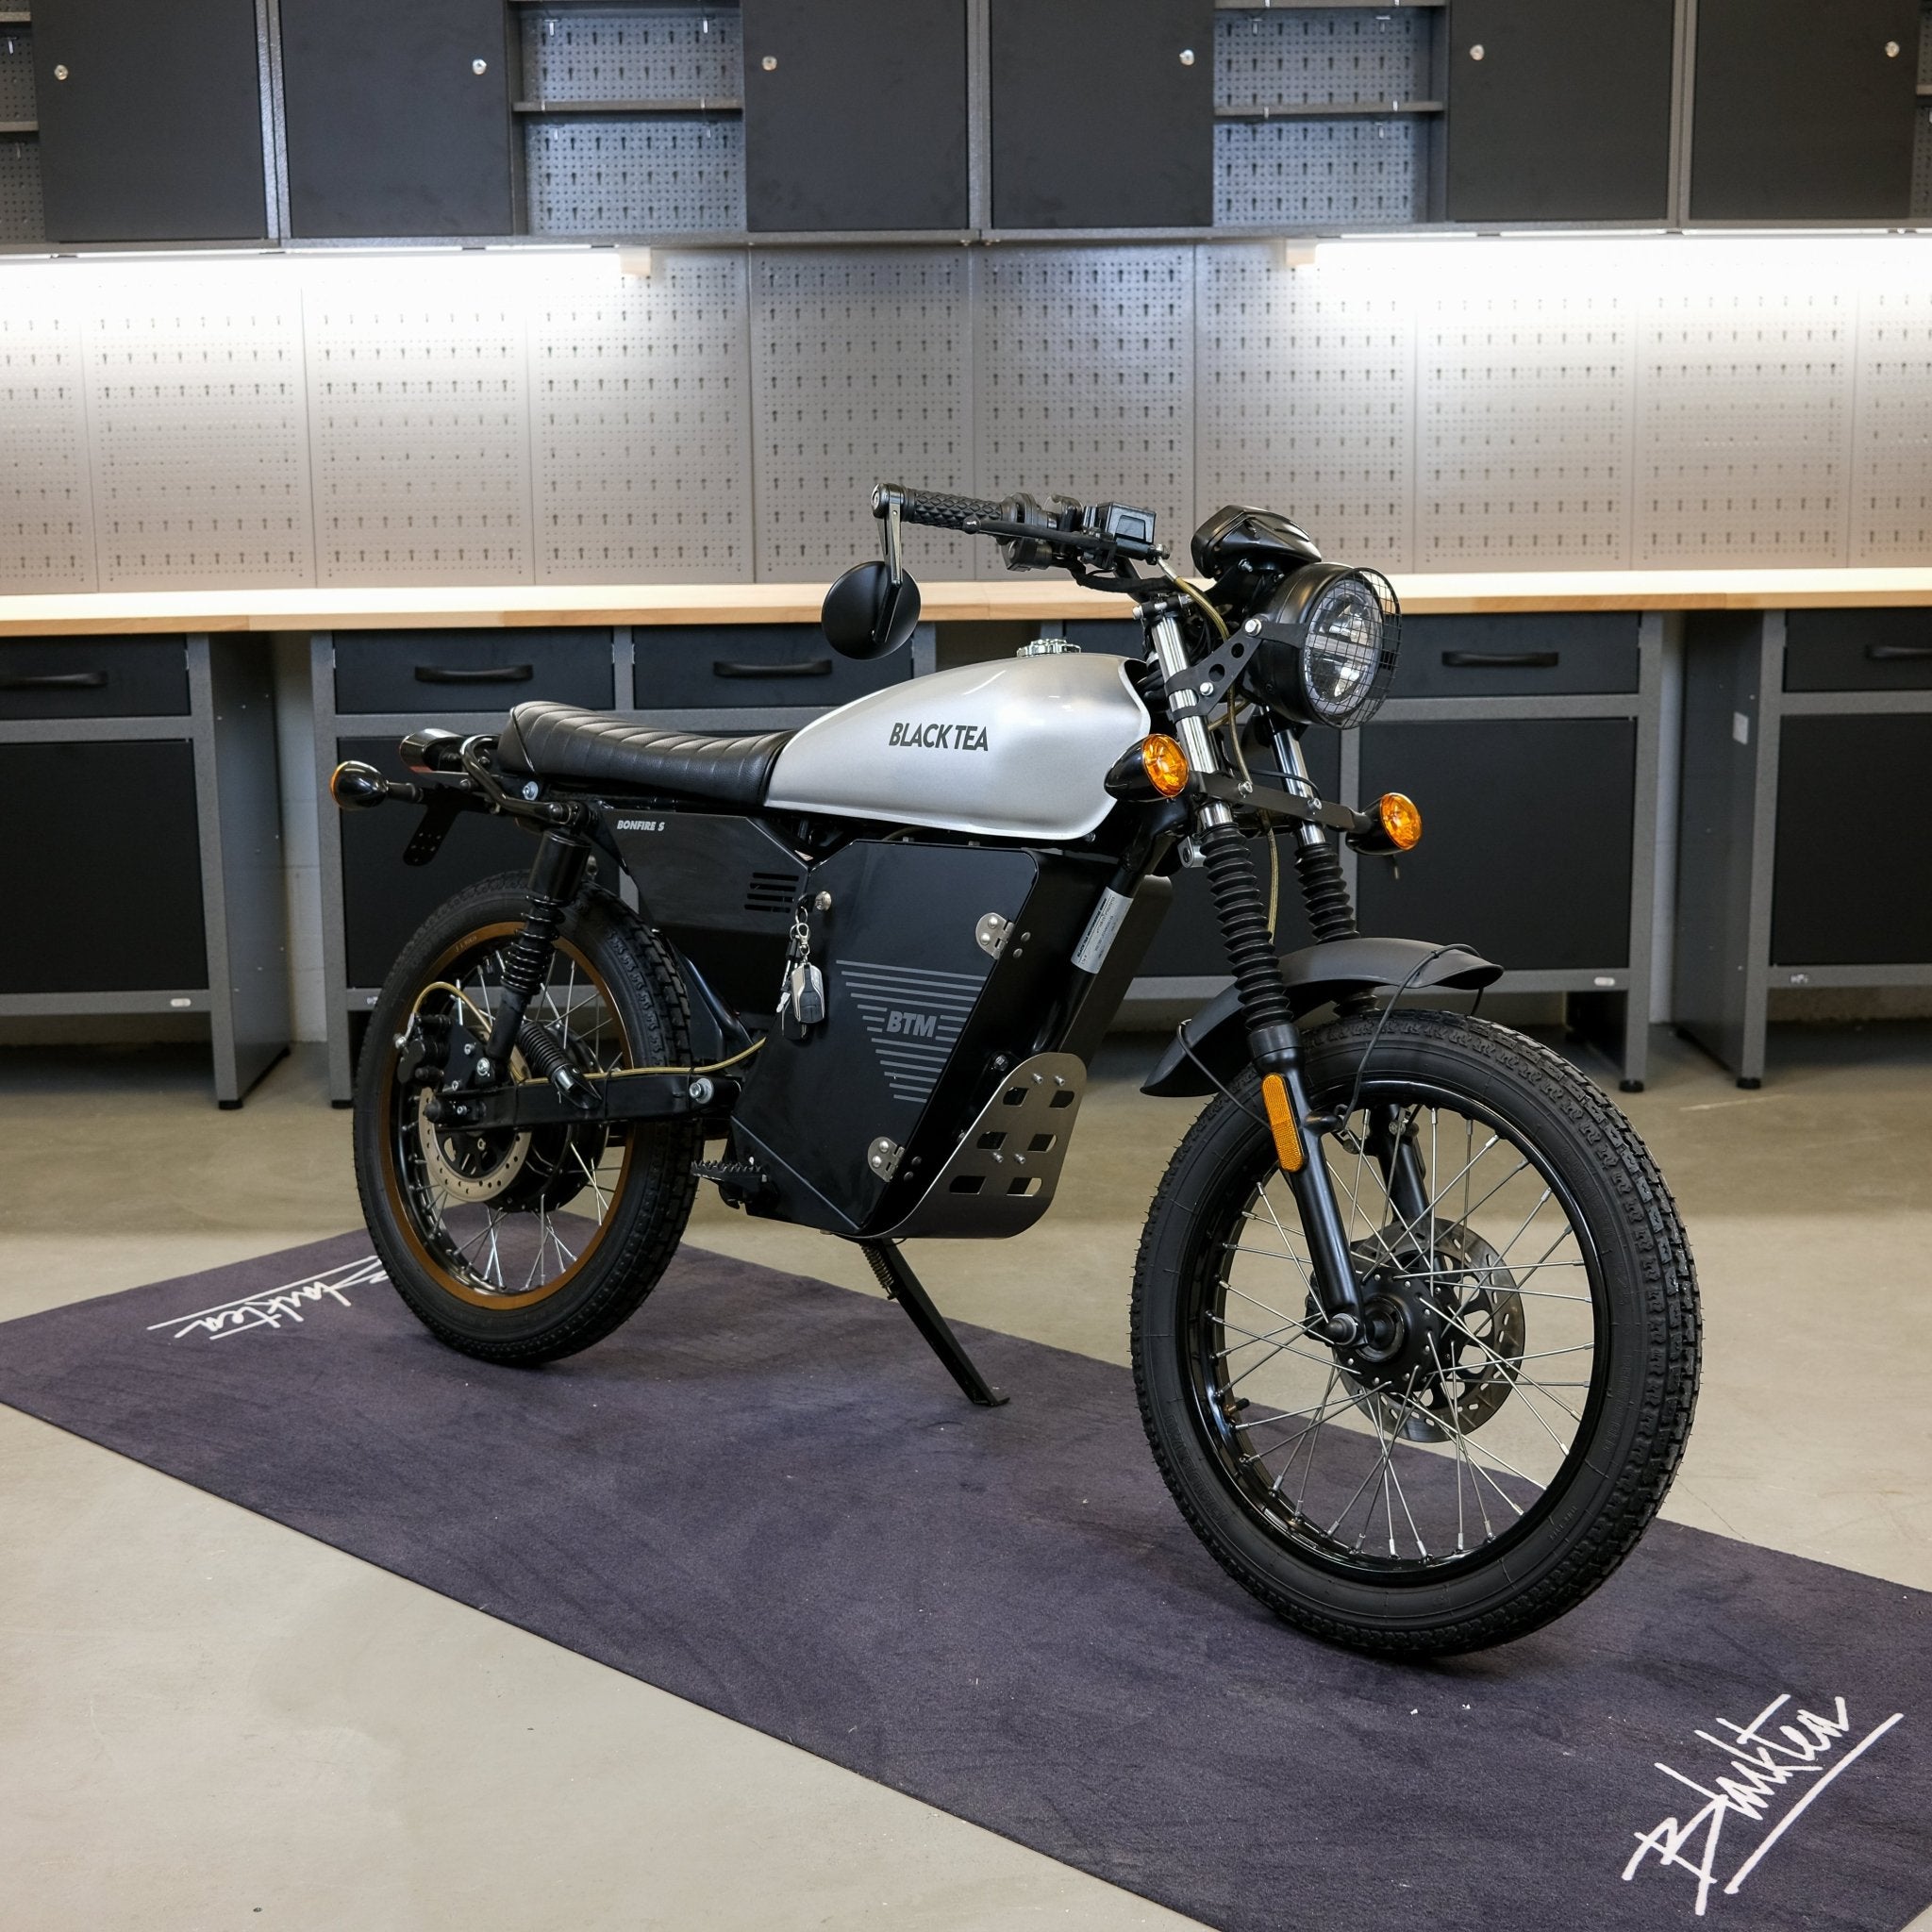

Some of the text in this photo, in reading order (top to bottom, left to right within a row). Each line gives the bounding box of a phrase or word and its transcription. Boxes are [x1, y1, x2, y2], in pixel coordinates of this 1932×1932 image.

[889, 723, 989, 751] BLACK TEA
[616, 820, 665, 832] BONFIRE S
[887, 1010, 938, 1038] BTM
